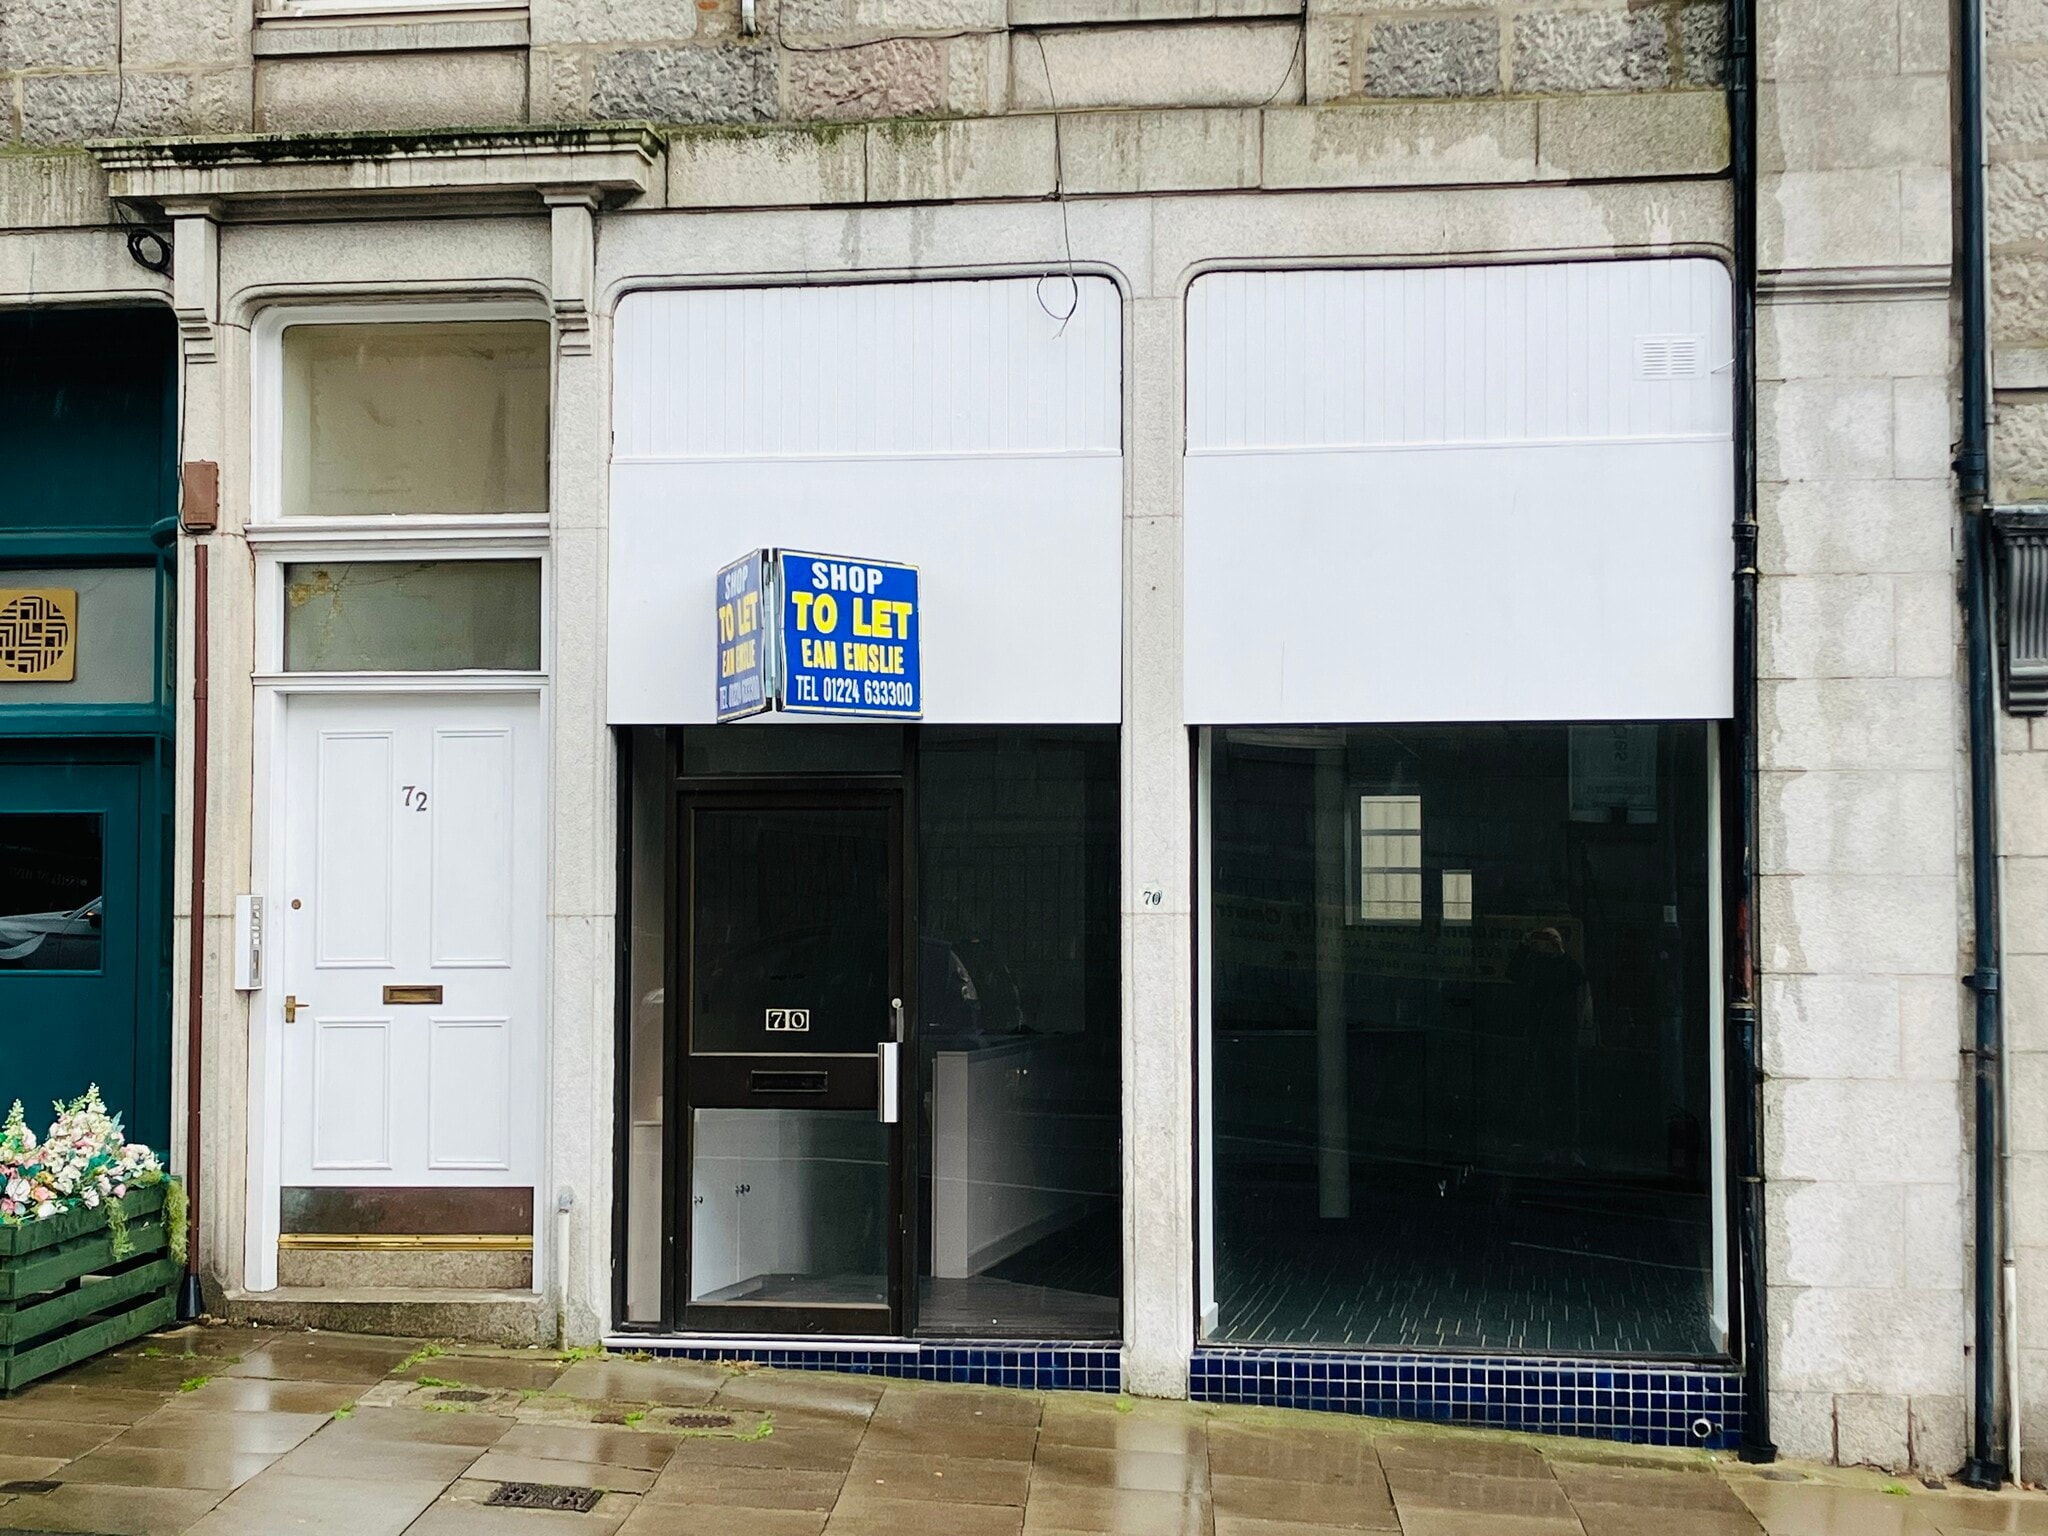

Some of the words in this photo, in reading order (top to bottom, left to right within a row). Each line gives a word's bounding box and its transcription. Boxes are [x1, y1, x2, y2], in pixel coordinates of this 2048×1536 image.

[724, 565, 748, 601] SHOP
[811, 561, 883, 594] SHOP
[718, 603, 735, 644] TO
[737, 590, 758, 636] LET
[791, 591, 838, 634] TO
[852, 597, 913, 640] LET
[801, 638, 837, 671] EAN
[842, 641, 905, 675] EMSLIE
[795, 674, 820, 702] TEL
[823, 676, 860, 704] 01224
[863, 679, 914, 708] 633300
[401, 785, 428, 812] 72
[1142, 890, 1163, 906] 70
[770, 1012, 806, 1029] 70
